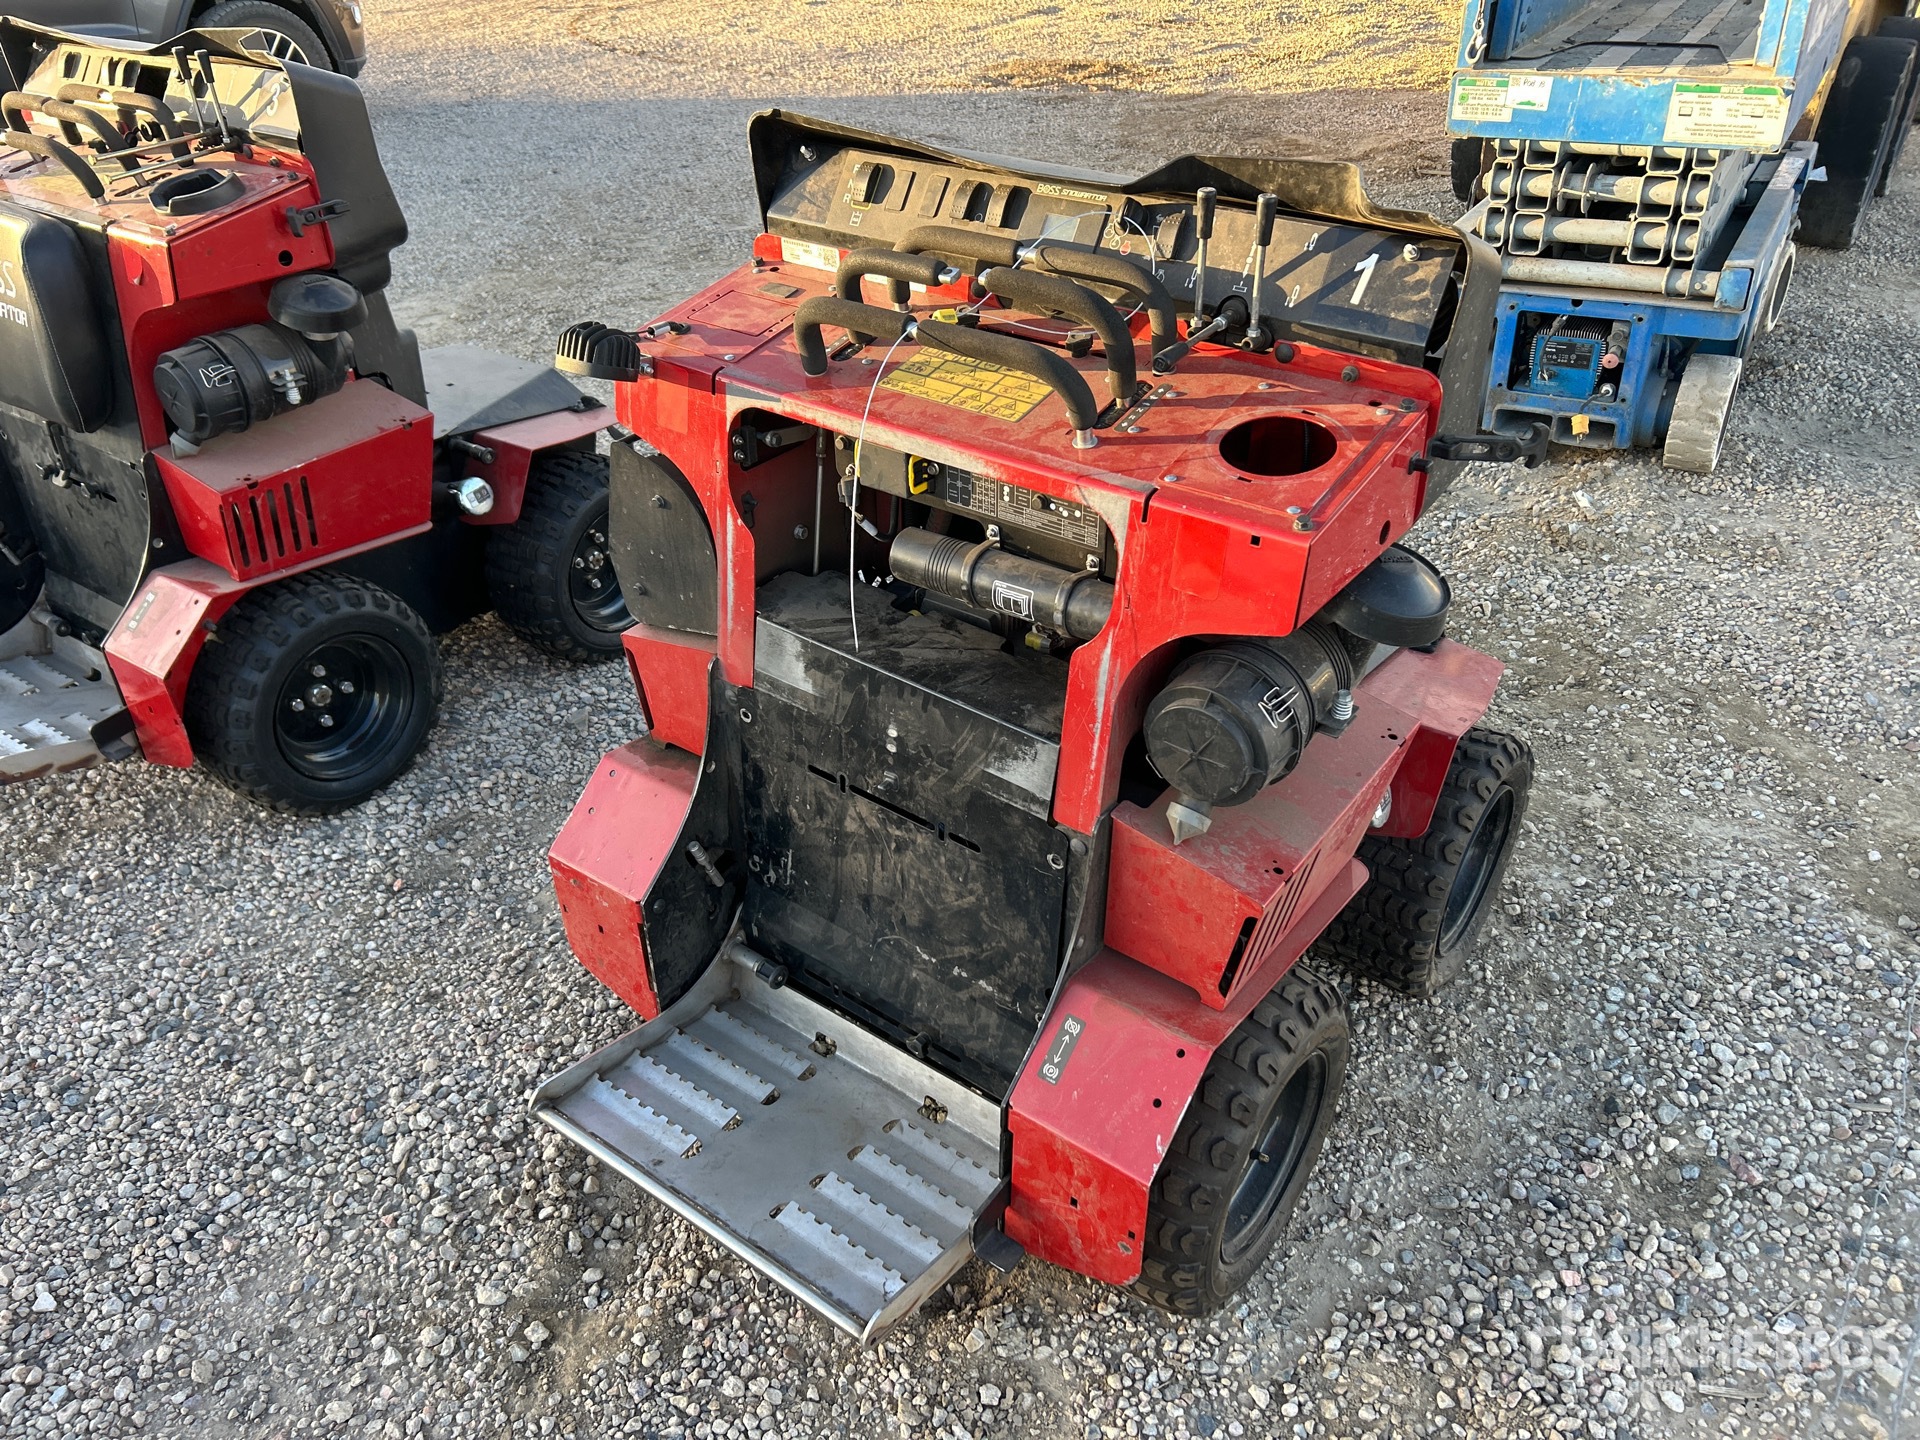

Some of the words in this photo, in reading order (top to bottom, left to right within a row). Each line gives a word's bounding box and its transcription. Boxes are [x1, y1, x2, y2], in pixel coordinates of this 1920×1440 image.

[266, 82, 280, 117] 3
[842, 193, 851, 204] R
[1036, 183, 1062, 196] BOSS
[1352, 253, 1379, 304] 1
